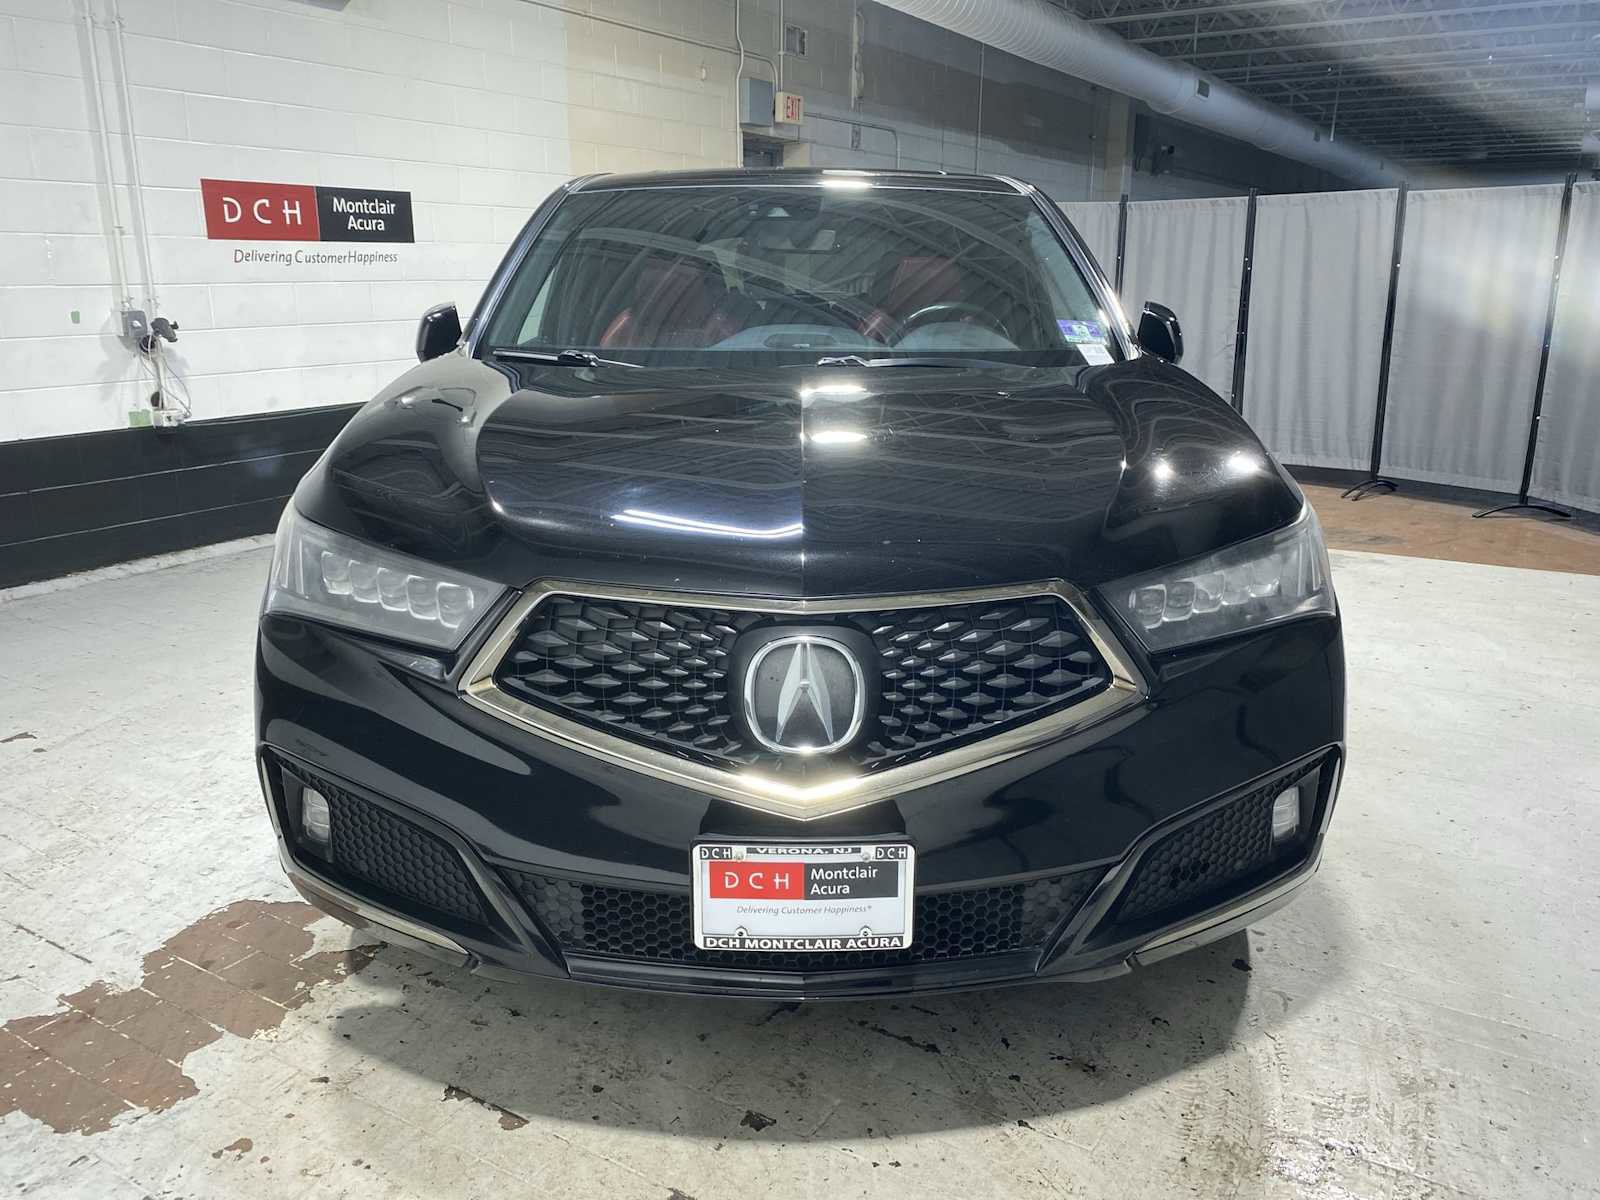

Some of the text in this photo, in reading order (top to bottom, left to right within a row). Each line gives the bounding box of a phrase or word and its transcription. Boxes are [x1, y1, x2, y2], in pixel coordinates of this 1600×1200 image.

[222, 197, 302, 225] DCH
[332, 197, 396, 215] Montclair
[347, 215, 385, 231] Acura
[234, 249, 292, 266] Delivering
[701, 848, 731, 859] DCH
[876, 847, 907, 859] DCH
[724, 871, 790, 890] DCH
[810, 866, 879, 881] Montclair
[810, 882, 850, 895] Acura
[736, 904, 779, 915] Delivering
[781, 905, 822, 914] Customer
[706, 936, 901, 950] DCH MONTCLAIR ACURA
